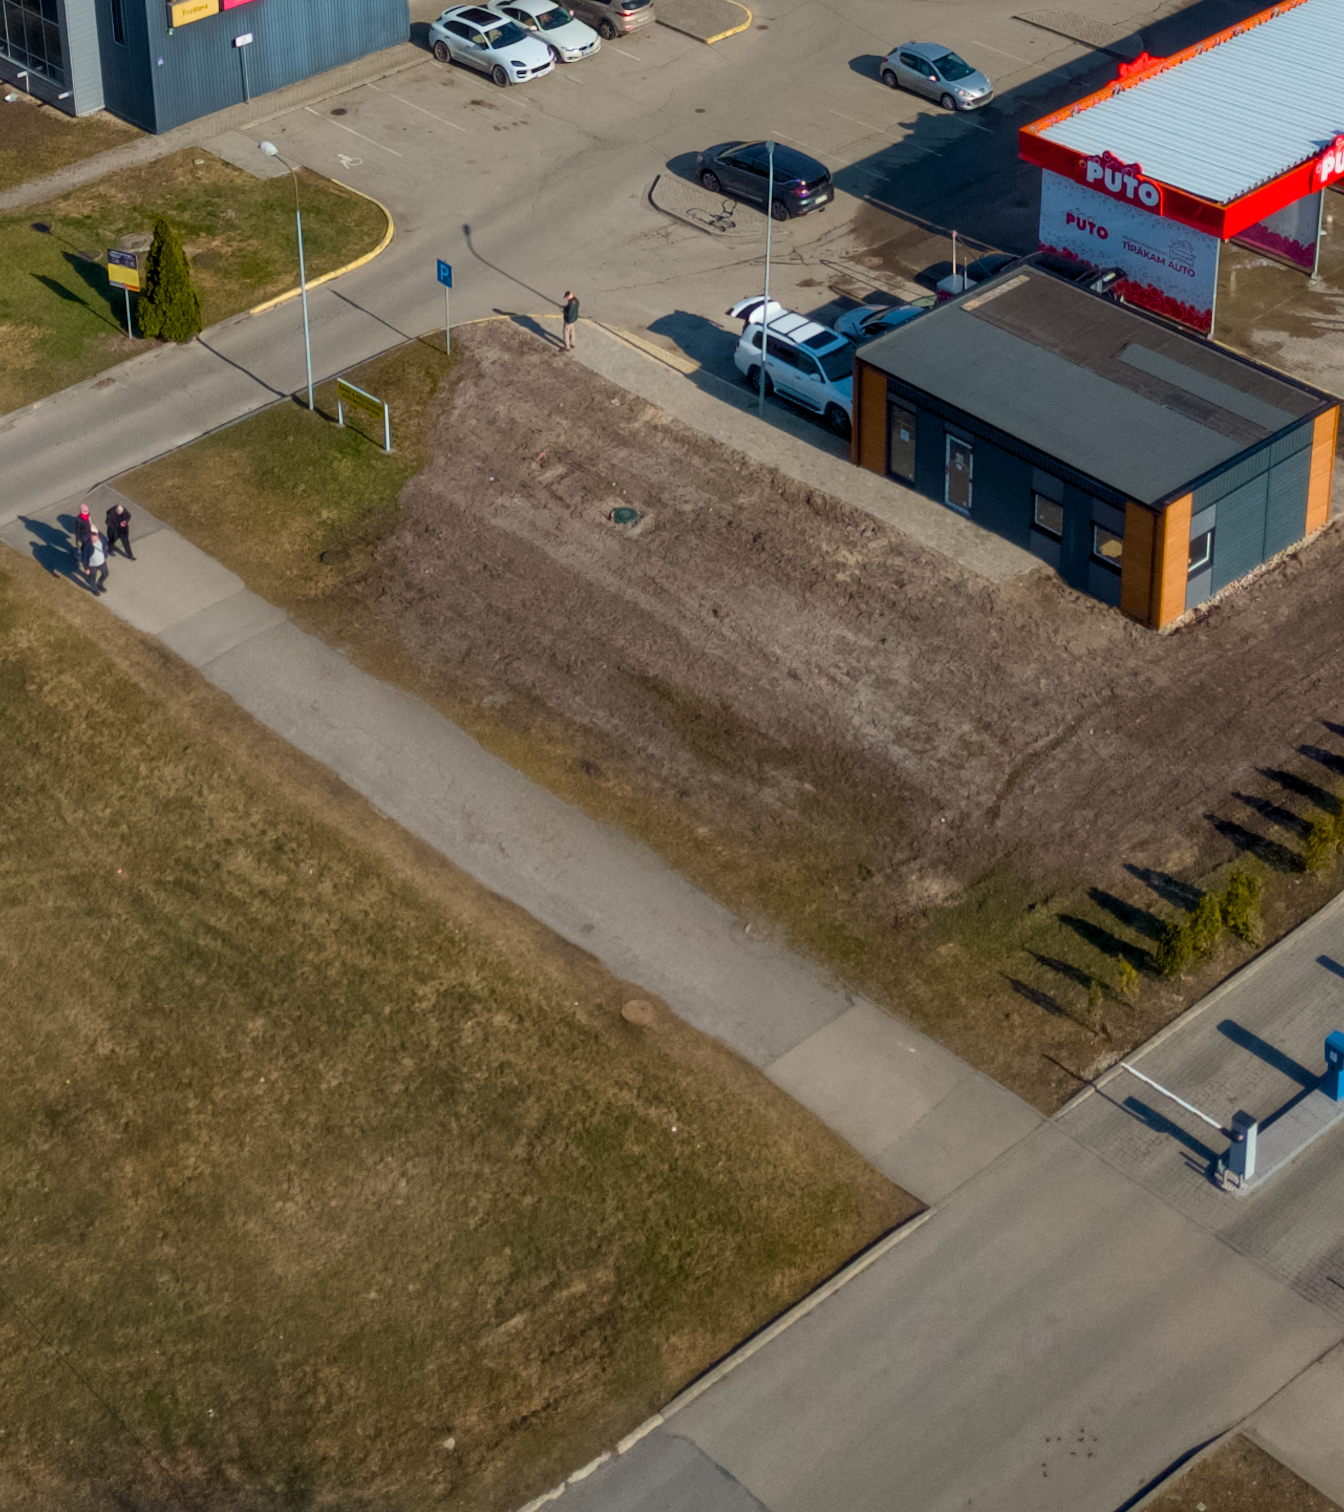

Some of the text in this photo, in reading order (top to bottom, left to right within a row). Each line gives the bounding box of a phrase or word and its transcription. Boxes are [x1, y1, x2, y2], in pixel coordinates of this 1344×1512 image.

[1086, 160, 1159, 207] PUTO
[1065, 211, 1109, 240] PUTO
[441, 263, 449, 281] P
[1167, 261, 1196, 278] AUTO
